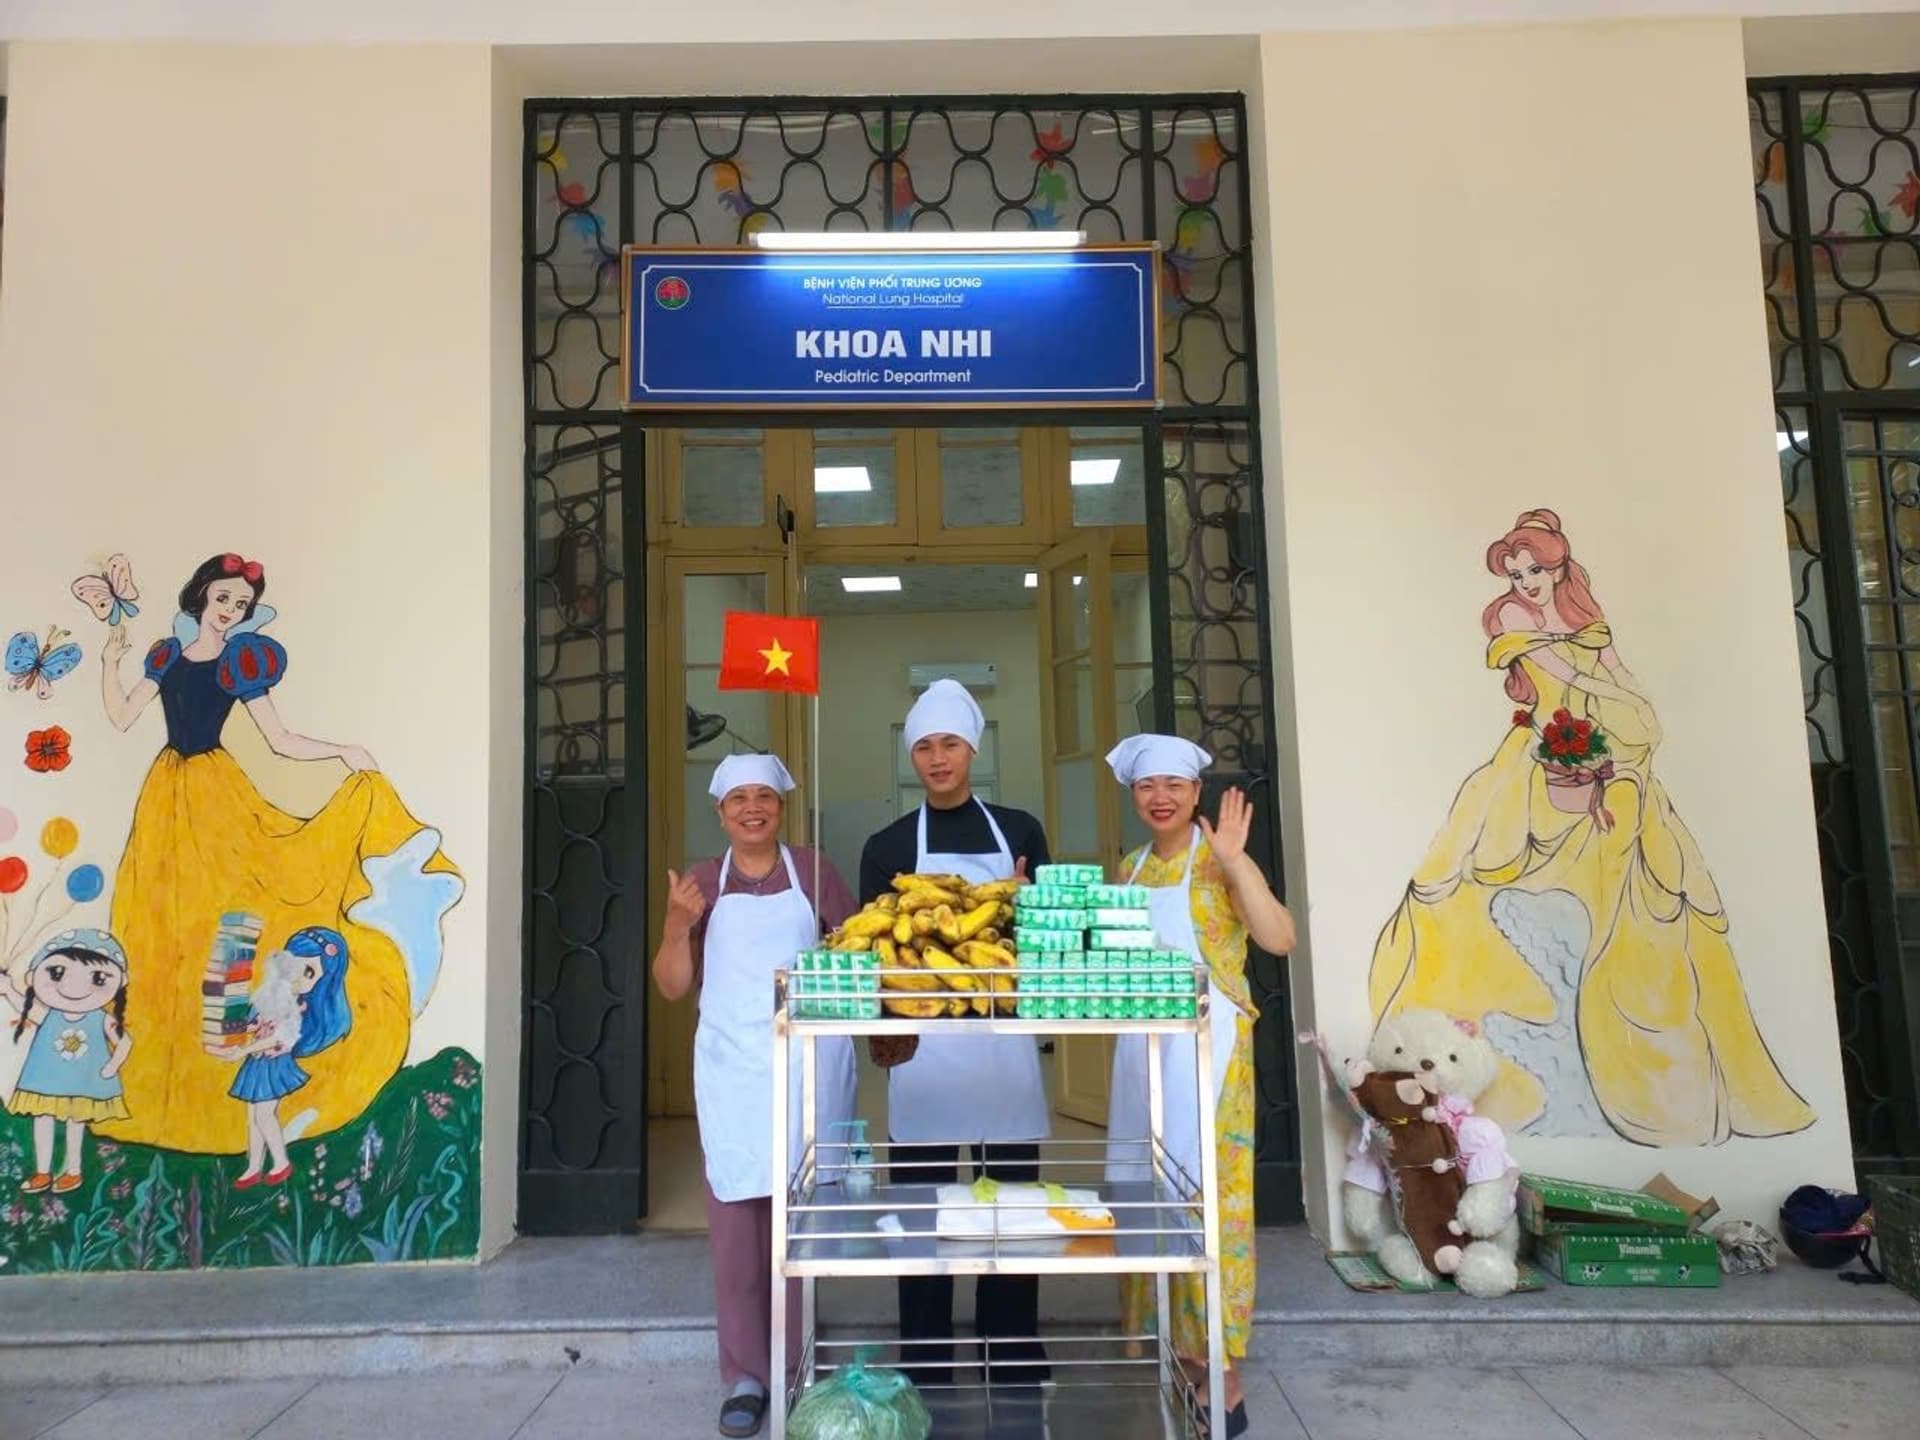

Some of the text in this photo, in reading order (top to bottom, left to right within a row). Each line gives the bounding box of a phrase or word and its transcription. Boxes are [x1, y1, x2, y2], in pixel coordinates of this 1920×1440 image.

[803, 277, 834, 290] BỆNH
[838, 276, 865, 290] VIỆN
[901, 278, 941, 288] TRUNG
[823, 293, 963, 306] National Lung Hospital
[795, 330, 992, 358] KHOA NHI
[815, 369, 971, 385] Pediatric Department
